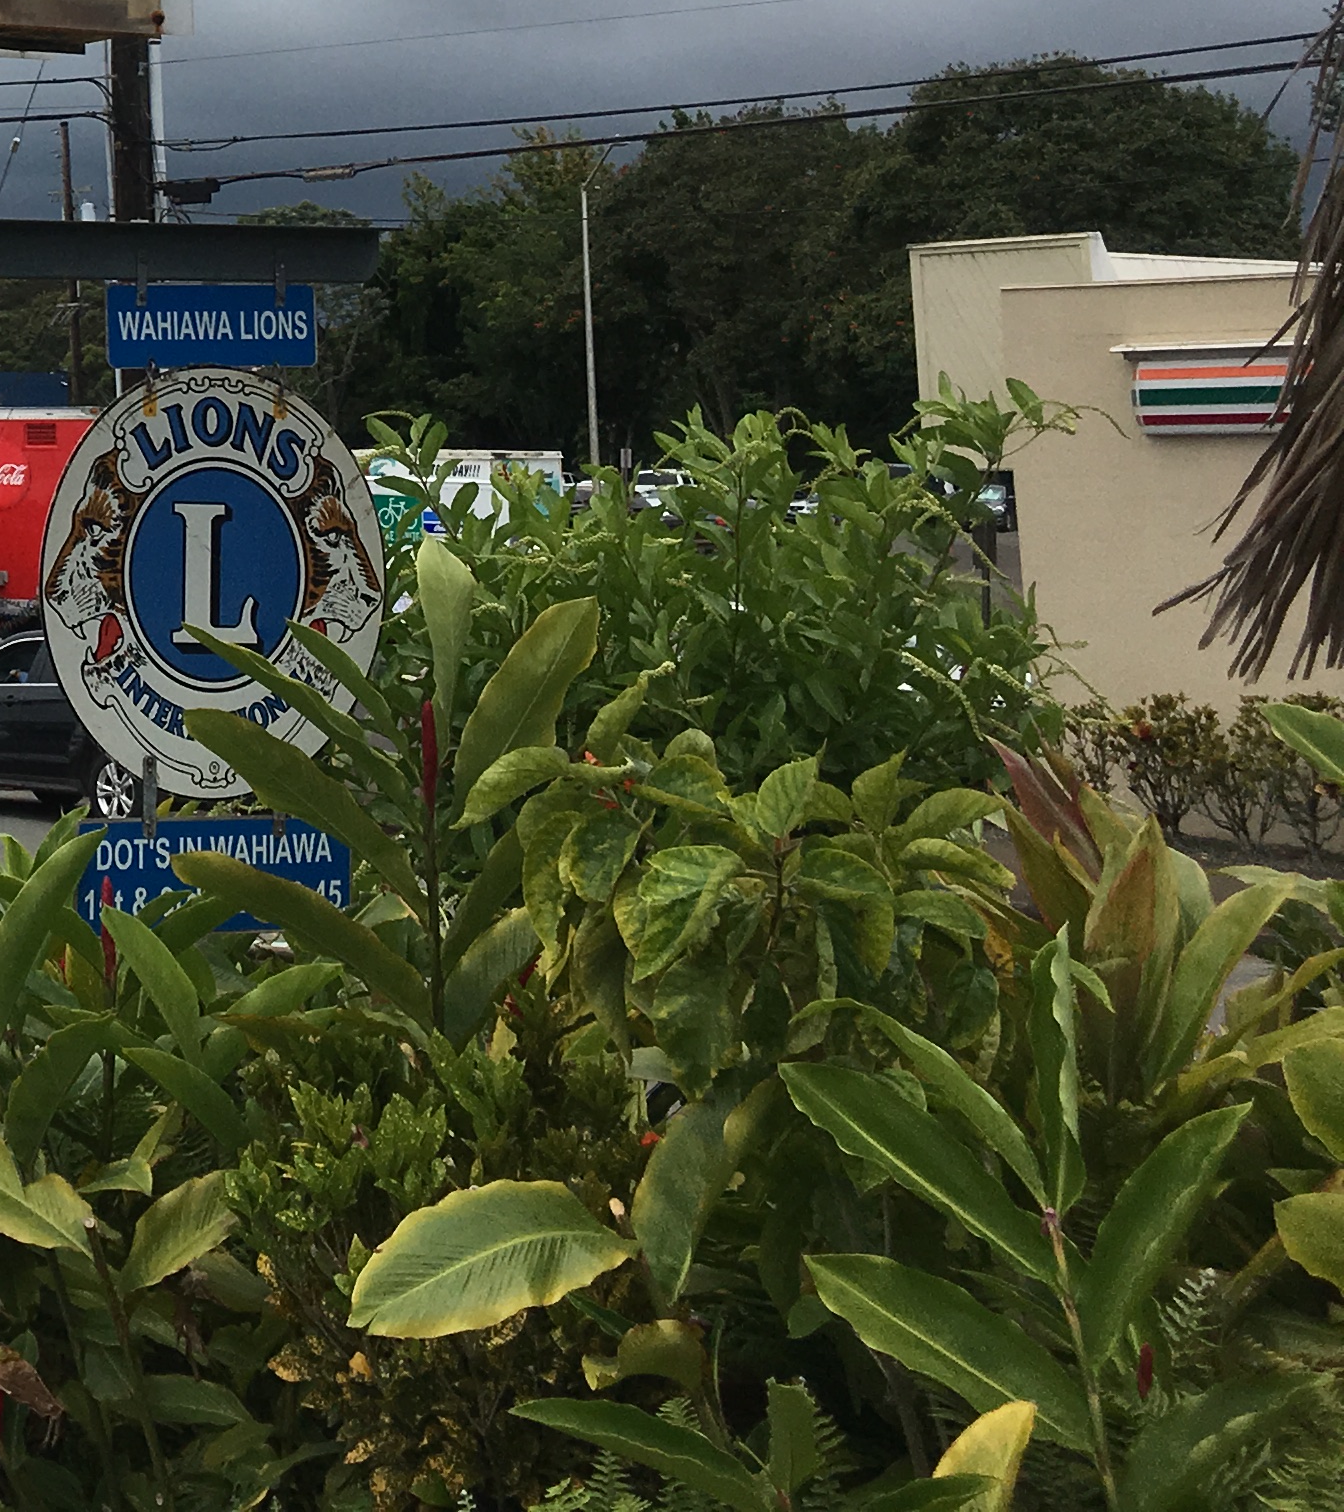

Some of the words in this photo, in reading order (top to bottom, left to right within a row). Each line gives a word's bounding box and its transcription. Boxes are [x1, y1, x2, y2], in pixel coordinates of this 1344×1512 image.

[118, 310, 233, 340] WAHIAWA
[240, 310, 308, 340] LIONS
[129, 396, 306, 481] LIONS
[172, 501, 260, 646] L
[96, 838, 170, 871] DOT'S
[210, 832, 332, 865] WAHIAWA
[84, 889, 124, 921] 1t
